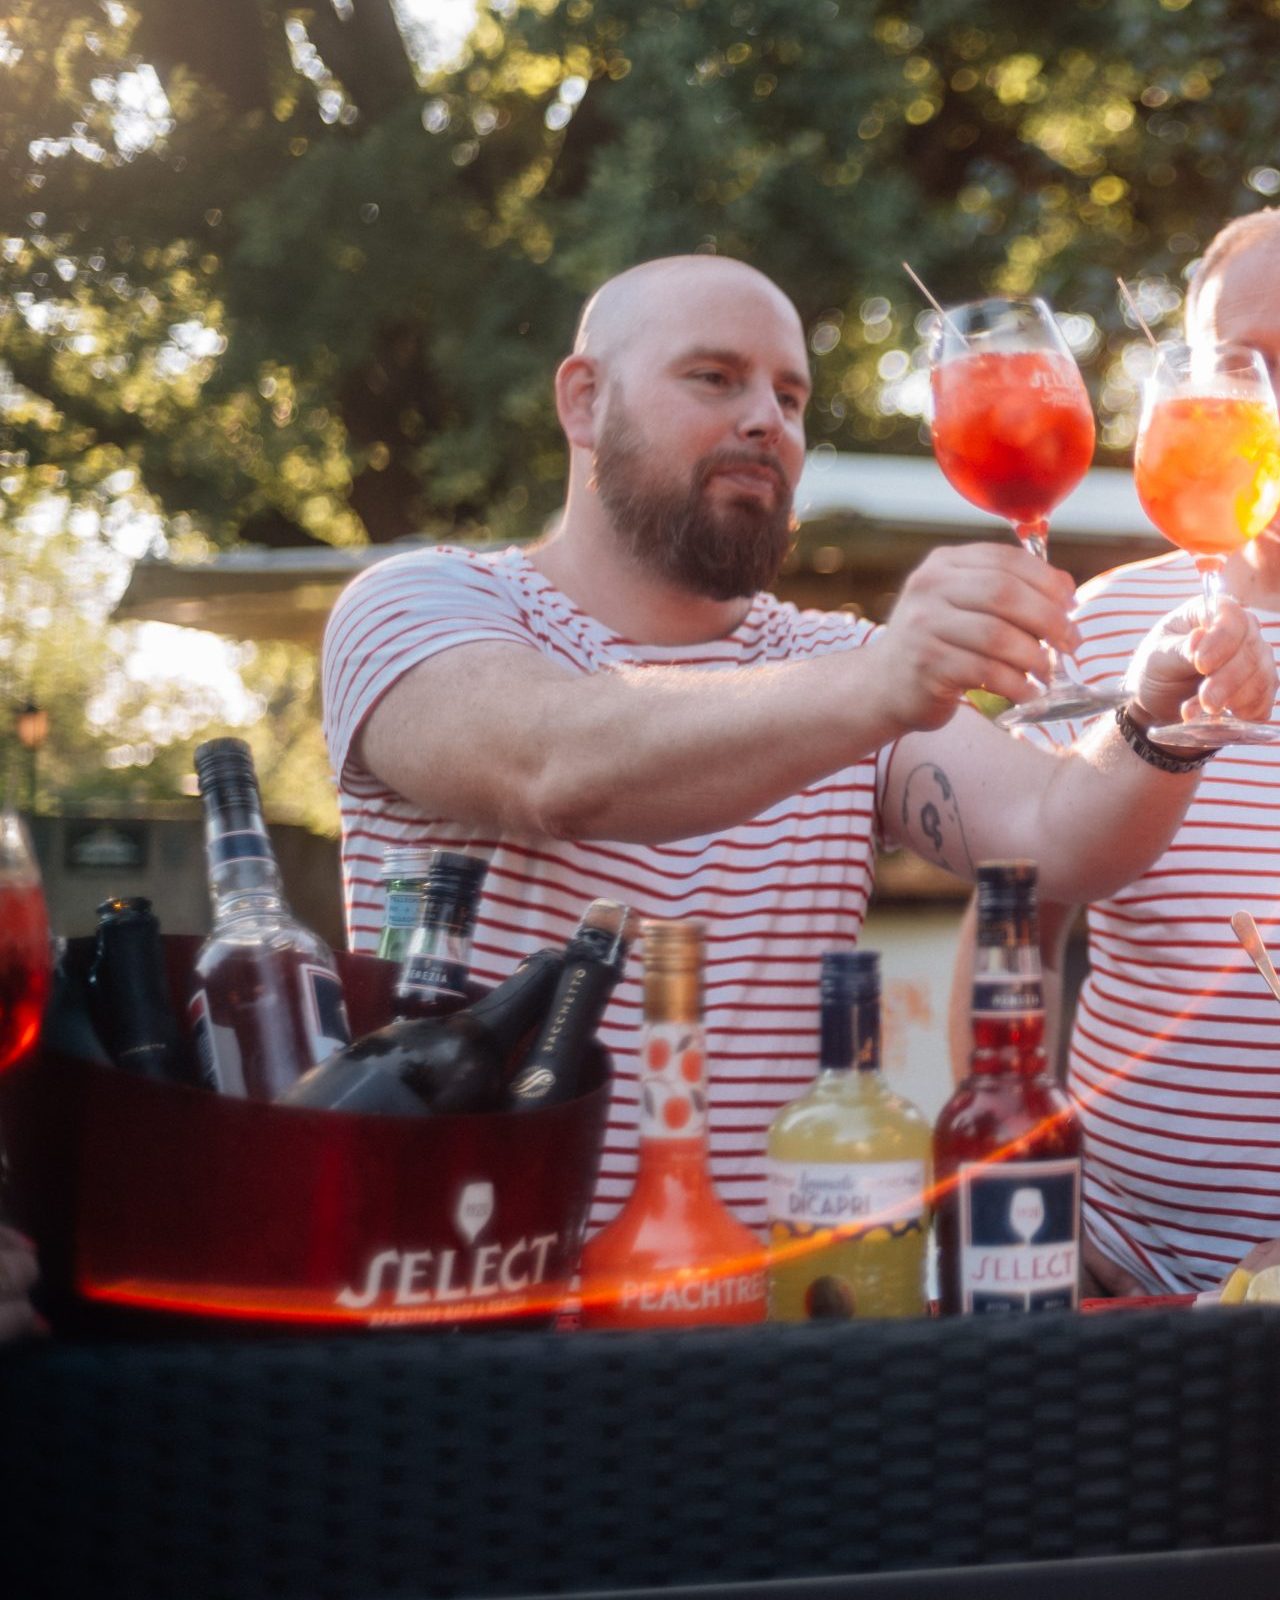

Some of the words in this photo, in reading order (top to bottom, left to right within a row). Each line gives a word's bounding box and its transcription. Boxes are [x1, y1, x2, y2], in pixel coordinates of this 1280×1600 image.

[543, 968, 587, 1051] SACCHETTO
[335, 1232, 558, 1309] SELECT
[621, 1272, 768, 1311] PEACHTRE
[972, 1251, 1075, 1281] SELECT
